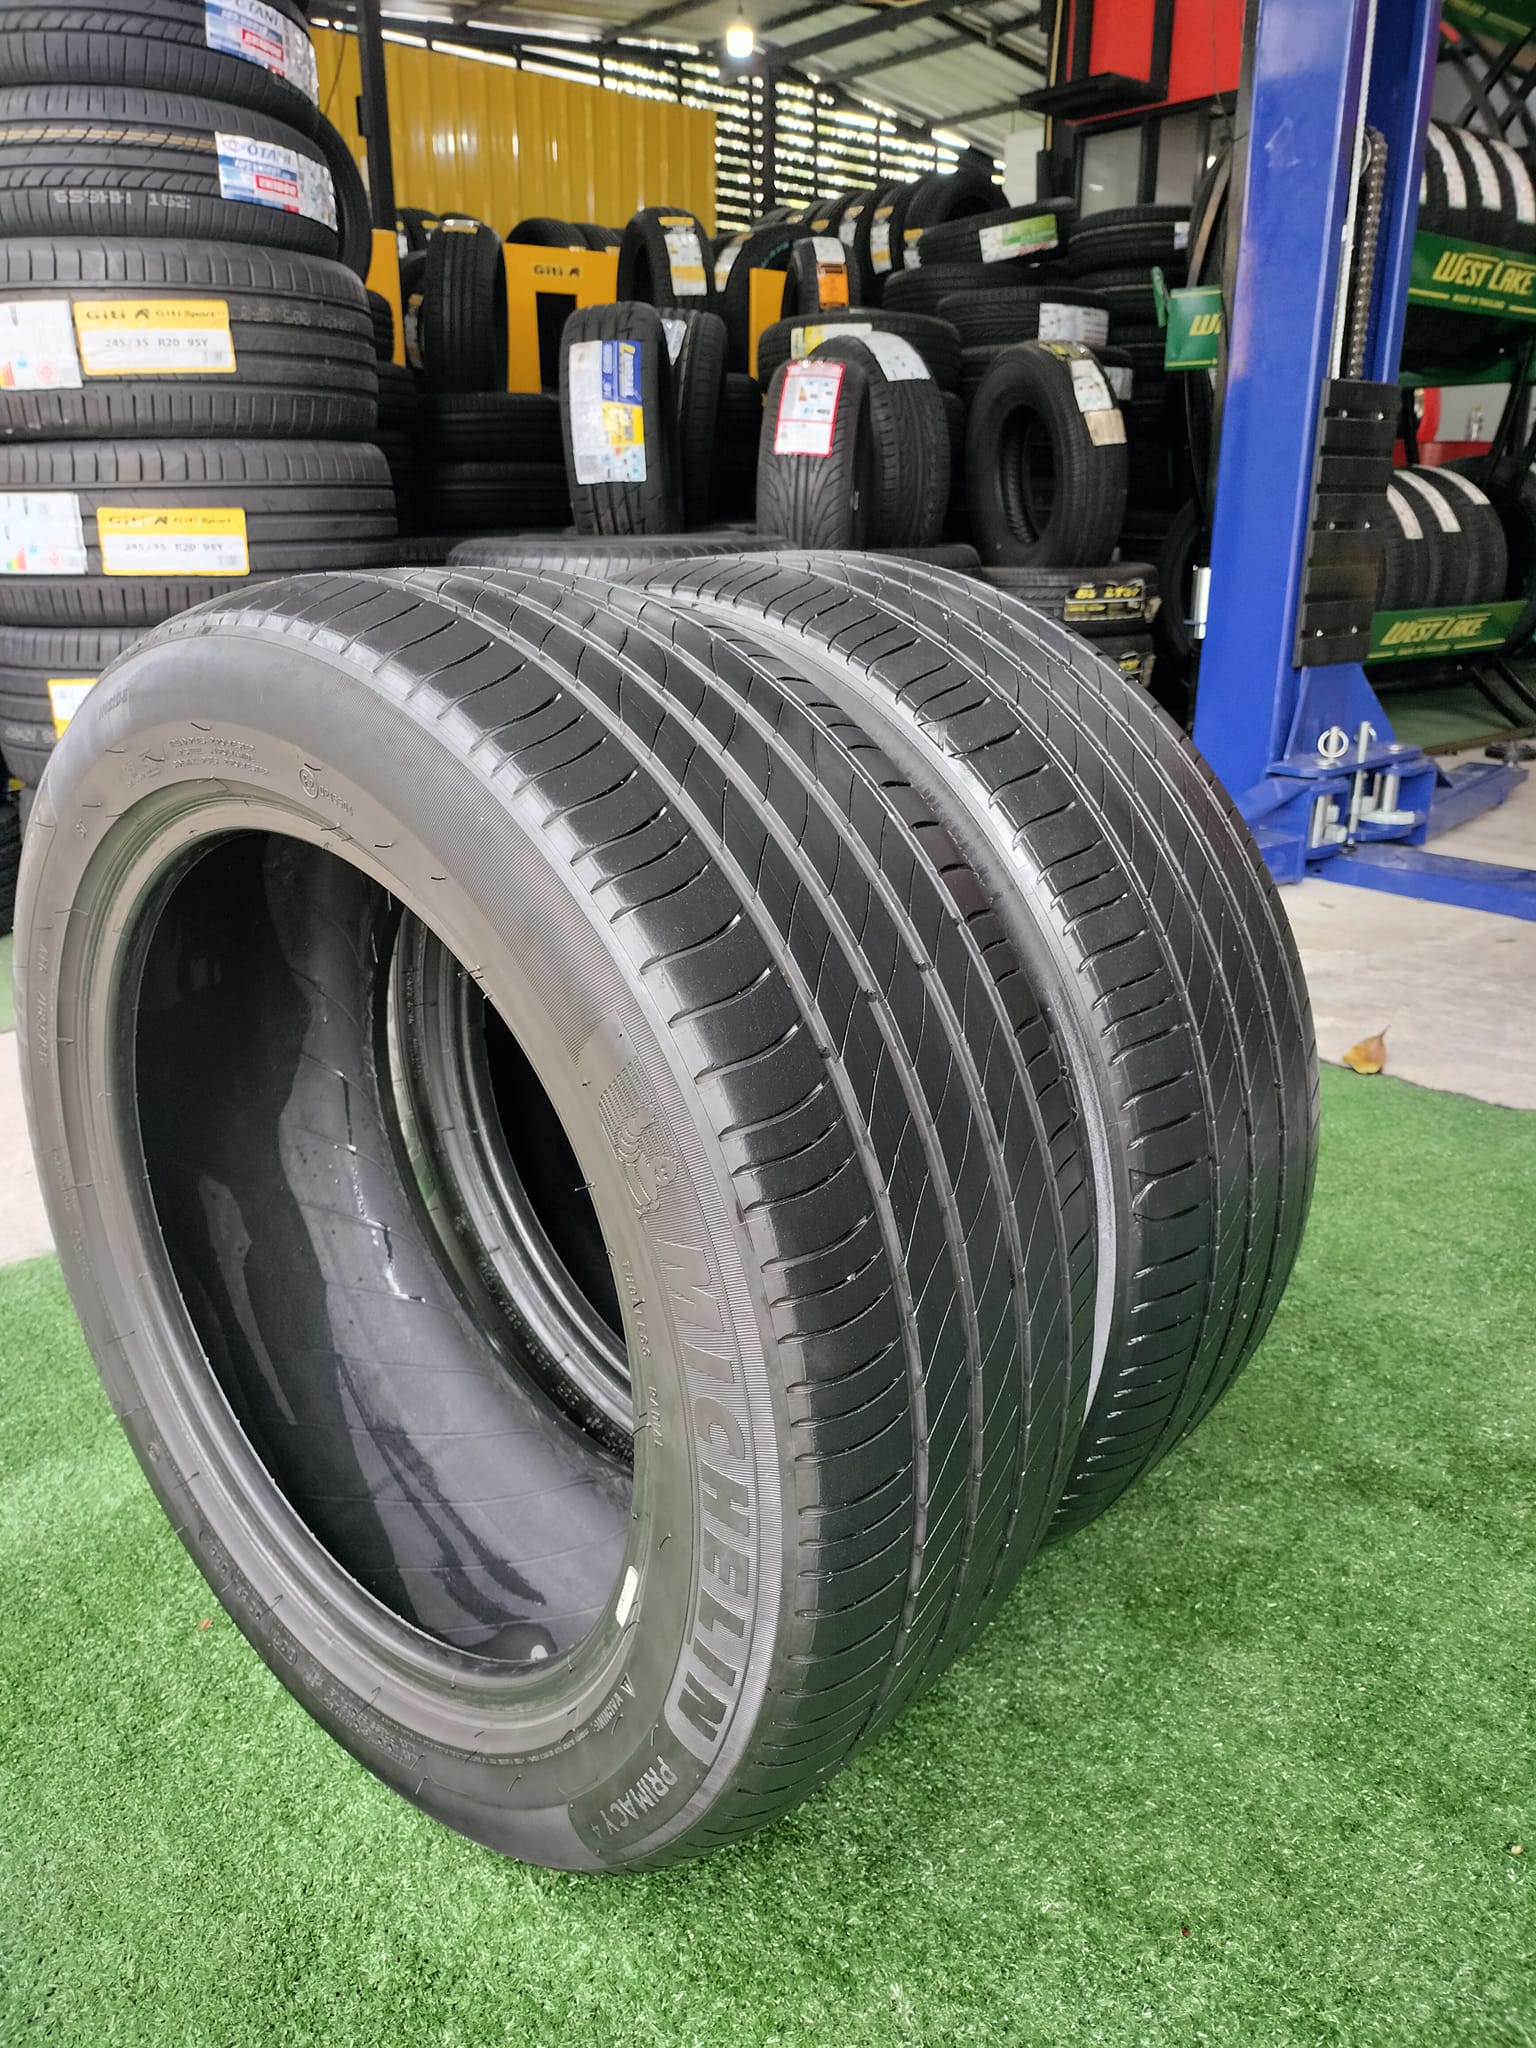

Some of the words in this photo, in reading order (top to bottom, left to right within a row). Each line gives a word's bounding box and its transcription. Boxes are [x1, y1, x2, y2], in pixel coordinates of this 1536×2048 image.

[247, 144, 292, 165] OTANI
[533, 264, 563, 277] Giti
[86, 309, 126, 320] Giti
[656, 1238, 750, 1743] MICHELIN
[600, 1755, 679, 1837] PRIMACY
